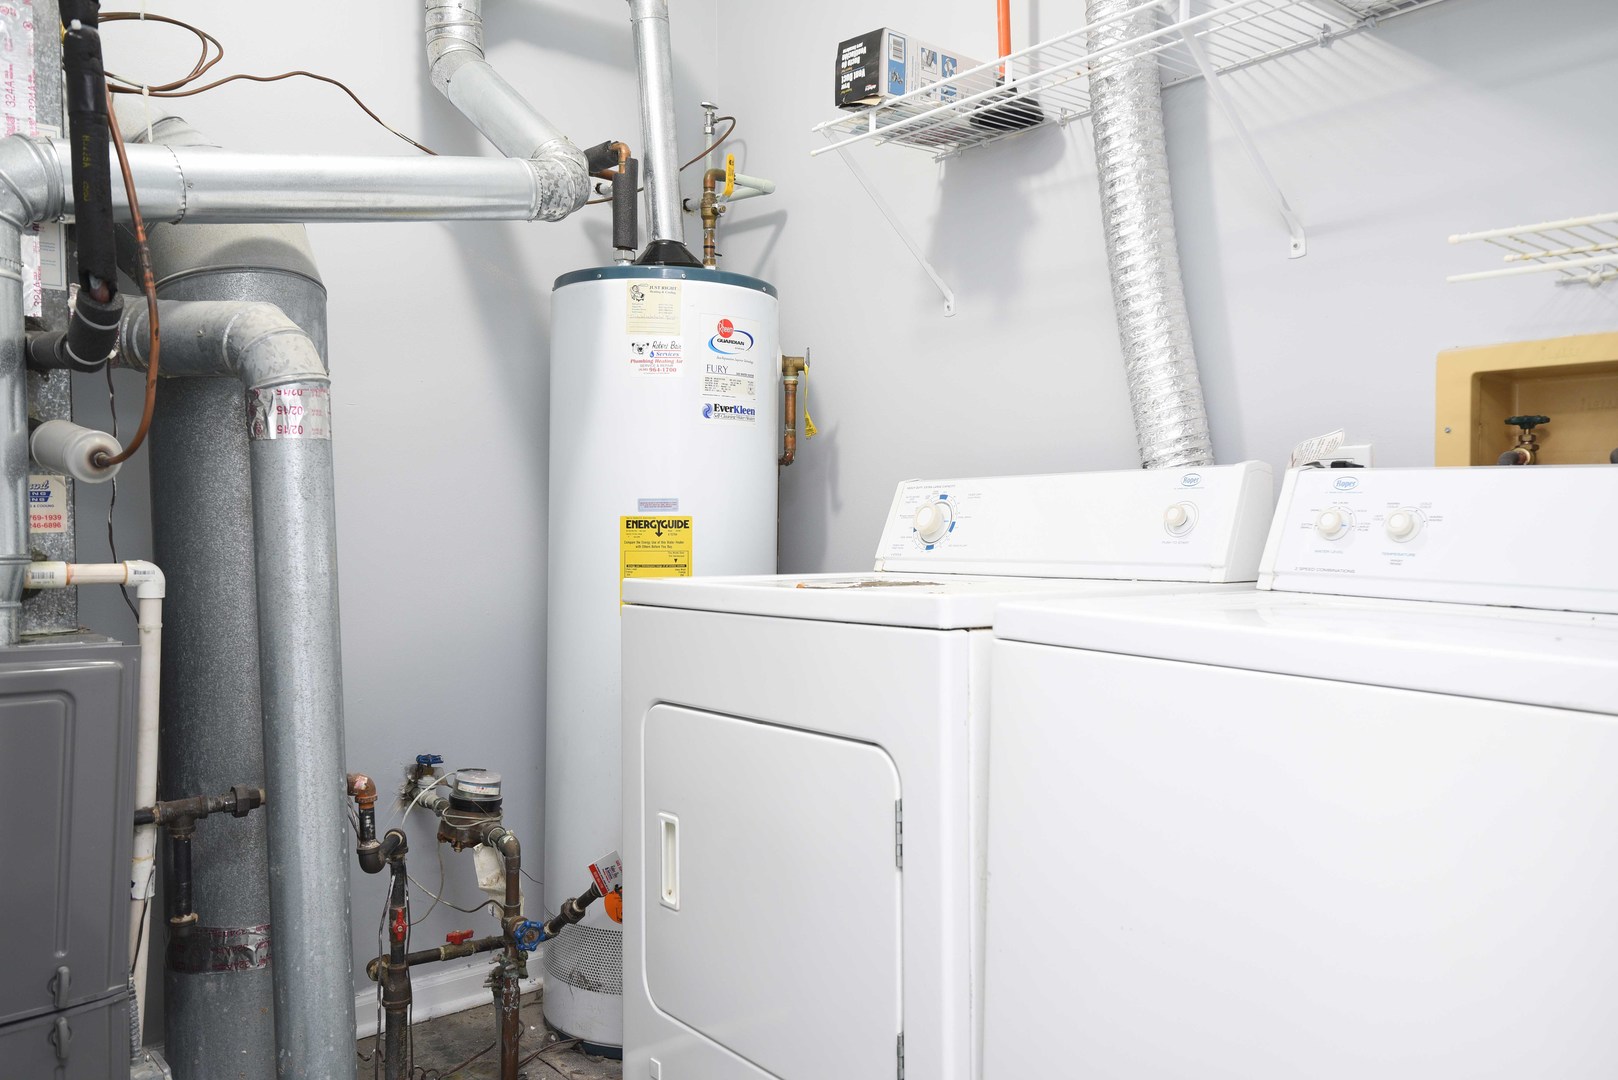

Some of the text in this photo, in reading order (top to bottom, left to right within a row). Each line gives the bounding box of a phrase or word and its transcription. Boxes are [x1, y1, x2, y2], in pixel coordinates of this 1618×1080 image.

[842, 72, 853, 84] Duct
[854, 68, 866, 80] Vent
[841, 82, 850, 90] Dryer
[5, 80, 16, 108] 324A
[652, 340, 668, 350] Robert
[706, 363, 728, 374] FURY
[276, 406, 304, 416] 02/15
[714, 404, 756, 416] EverKleen
[276, 424, 304, 434] 02/15
[626, 520, 690, 529] ENERGYGUIDE
